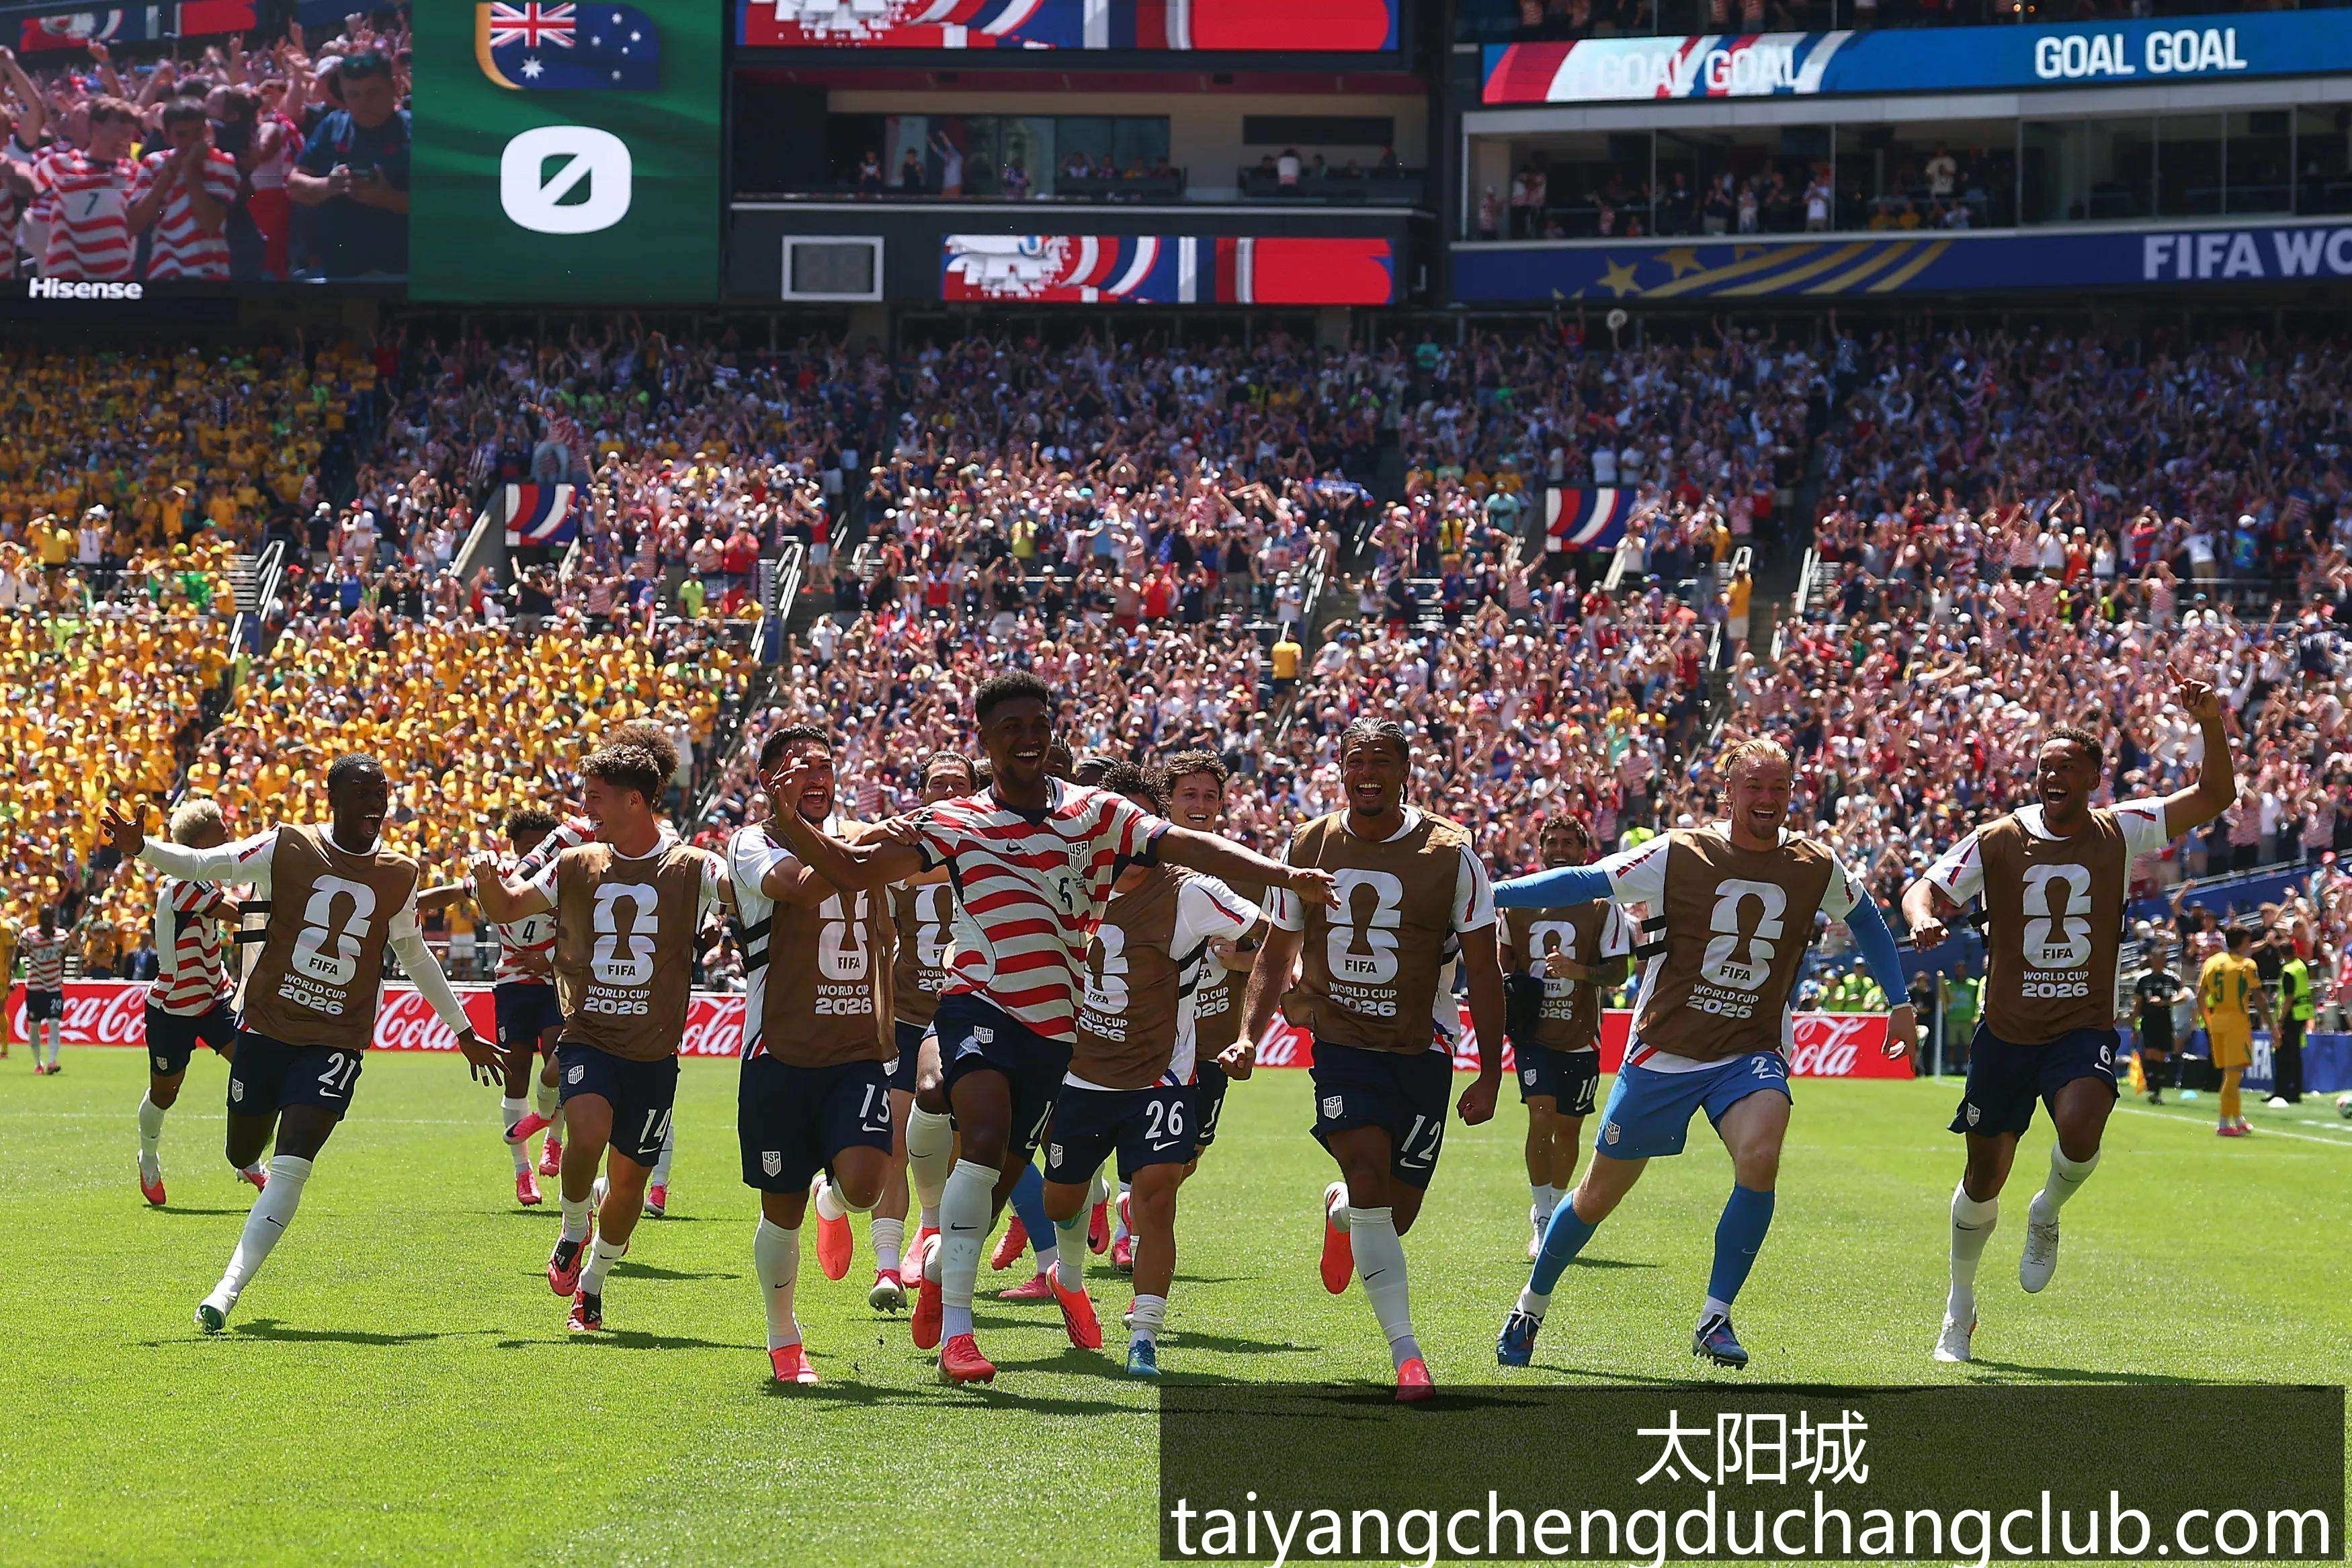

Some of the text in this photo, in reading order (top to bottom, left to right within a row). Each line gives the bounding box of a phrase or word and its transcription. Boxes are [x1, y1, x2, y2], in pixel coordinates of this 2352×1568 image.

[2035, 28, 2247, 79] GOAL GOAL
[1706, 44, 1800, 89] GOAL
[2143, 233, 2264, 280] FIFA
[28, 277, 143, 300] Hisense
[1068, 842, 1088, 856] USA
[522, 920, 536, 943] 4
[2042, 949, 2074, 959] FIFA
[308, 957, 339, 975] FIFA
[607, 964, 636, 976] FIFA
[837, 957, 861, 969] FIFA
[1345, 959, 1377, 974] FIFA
[1720, 965, 1751, 982] FIFA
[2023, 970, 2089, 982] WORLD CUP
[283, 973, 347, 1001] WORLD CUP
[587, 985, 650, 1000] WORLD CUP
[817, 985, 869, 996] WORLD CUP
[918, 978, 943, 992] 20
[1329, 982, 1397, 999] WORLD CUP
[2022, 982, 2089, 998] 2026
[278, 984, 345, 1015] 2026
[1210, 987, 1229, 1000] CUP
[1693, 984, 1759, 1005] WORLD CUP
[583, 997, 649, 1015] 2026
[815, 998, 872, 1014] 2026
[1556, 1000, 1574, 1008] CUP
[1685, 996, 1753, 1019] 2026
[1081, 1007, 1128, 1029] ORLD CUP
[1539, 1008, 1572, 1020] 026
[975, 1027, 993, 1035] USA
[2100, 1045, 2111, 1065] 6
[318, 1052, 357, 1091] 21
[569, 1064, 584, 1075] USA
[233, 1079, 243, 1090] USA
[1577, 1076, 1597, 1104] 10
[859, 1084, 890, 1123] 15
[1324, 1096, 1341, 1106] USA
[639, 1107, 672, 1143] 14
[1144, 1100, 1184, 1139] 26
[1607, 1121, 1620, 1133] USA
[1401, 1115, 1442, 1161] 12
[763, 1151, 780, 1162] USA
[1050, 1143, 1062, 1155] USA
